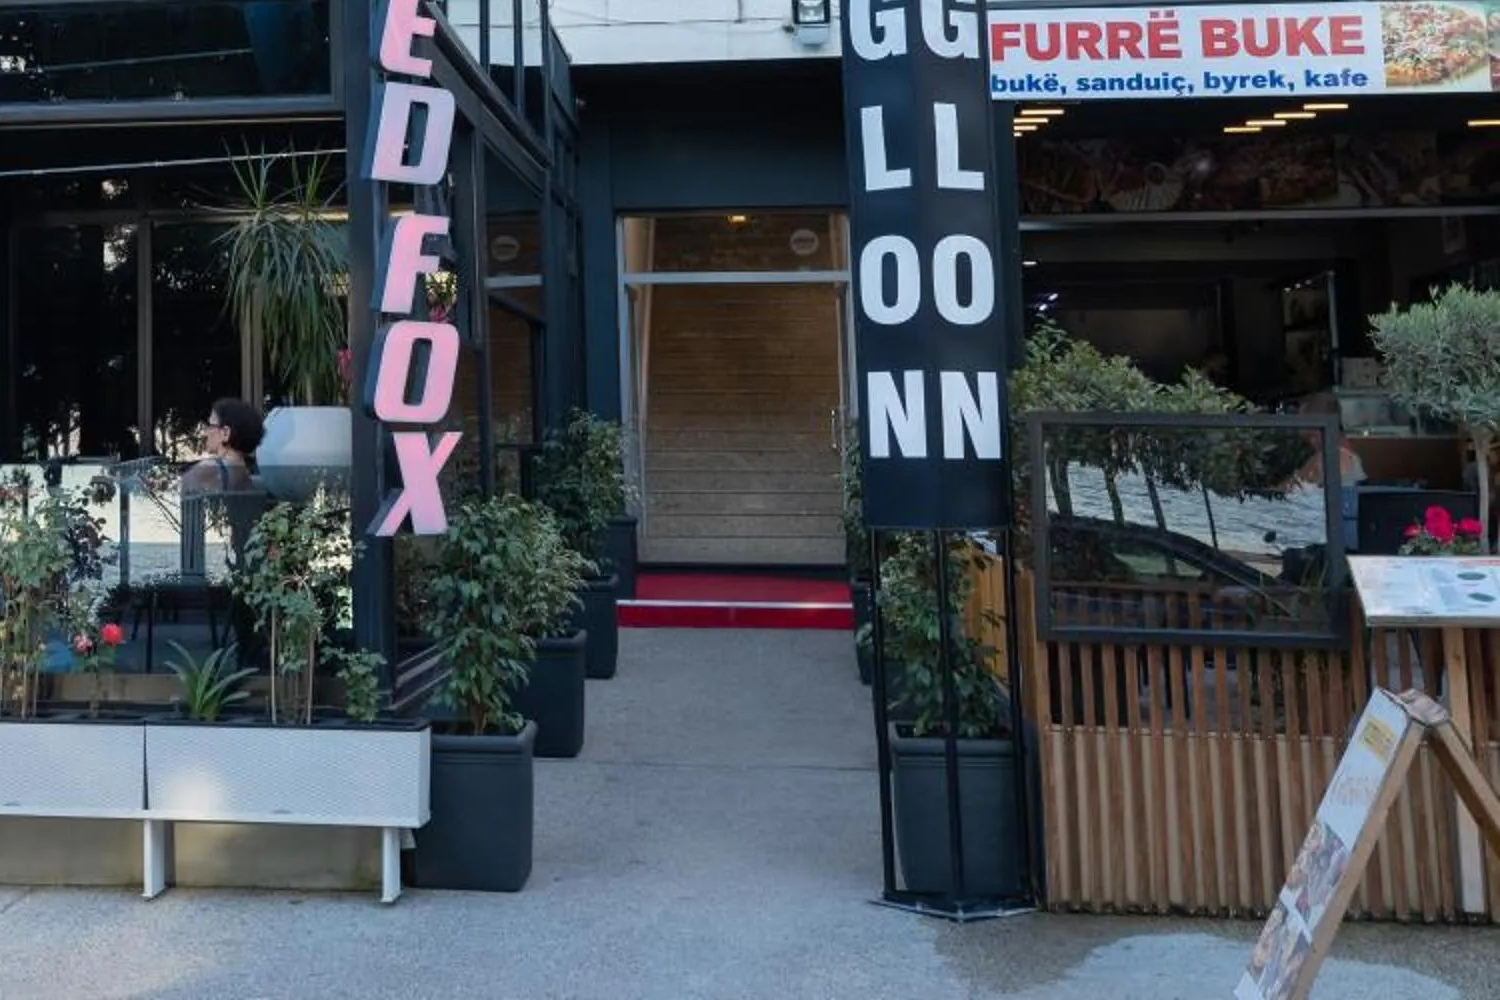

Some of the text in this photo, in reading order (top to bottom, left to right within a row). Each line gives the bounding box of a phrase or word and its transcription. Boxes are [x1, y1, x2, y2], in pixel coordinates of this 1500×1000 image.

[990, 10, 1366, 63] FURRË BUKE
[991, 69, 1369, 97] bukë, sanduiç, byrek, kafe
